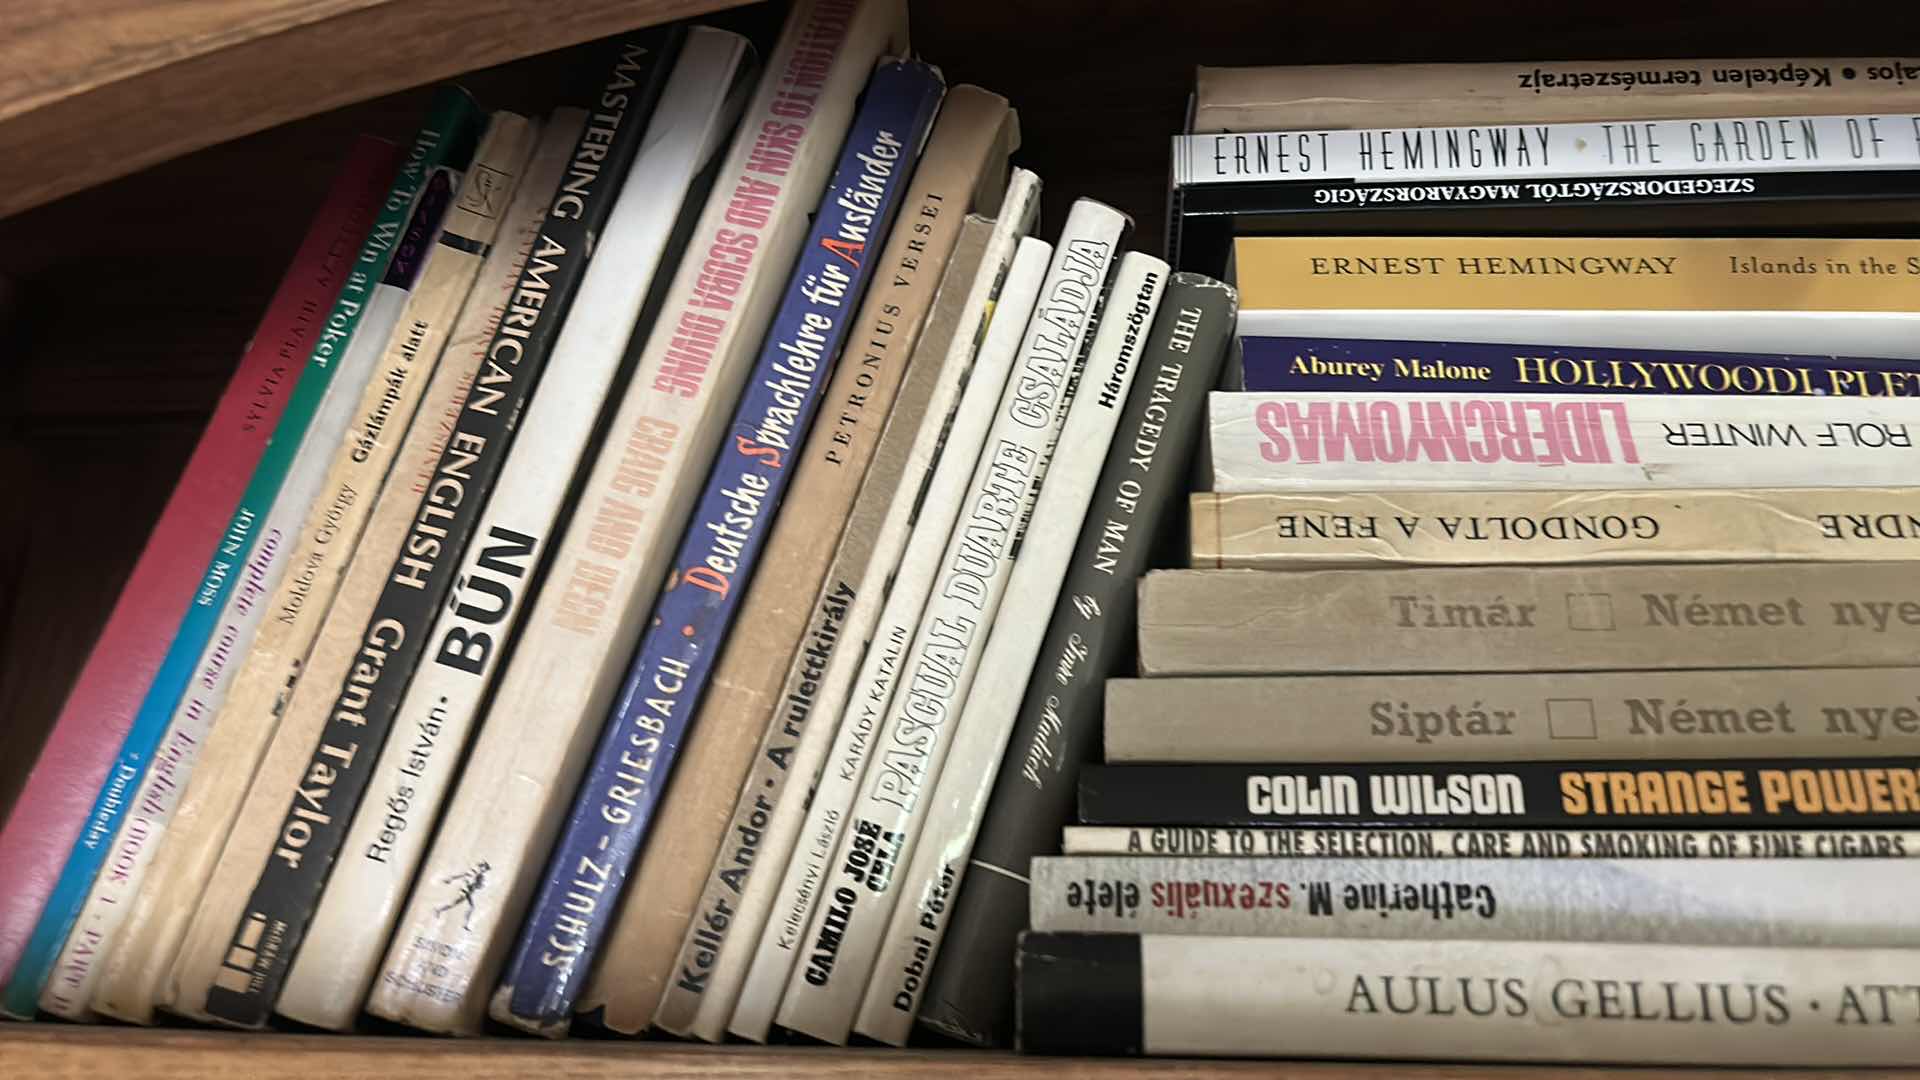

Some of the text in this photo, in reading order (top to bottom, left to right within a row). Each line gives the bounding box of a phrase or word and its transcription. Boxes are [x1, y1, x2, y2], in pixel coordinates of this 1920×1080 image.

[770, 89, 818, 119] TO
[1518, 69, 1701, 94] természetrajz
[1713, 66, 1832, 88] Képtelen
[403, 128, 442, 180] How
[551, 43, 650, 221] MASTERING
[745, 119, 806, 177] SKIN
[1214, 133, 1329, 176] ERNEST
[1359, 127, 1550, 172] HEMINGWAY
[1602, 123, 1663, 165] THE
[1689, 120, 1819, 162] GARDEN
[1845, 117, 1885, 159] OF
[724, 174, 782, 230] AND
[1313, 177, 1756, 206] SZEGEDORSZÁGTÓL MAGYARORSZÁGIG
[346, 271, 368, 294] at
[359, 221, 400, 264] Win
[687, 227, 760, 312] SCUBA
[1310, 257, 1445, 276] ERNEST
[1458, 256, 1678, 276] HEMINGWAY
[1728, 255, 1818, 275] Islands
[1825, 258, 1851, 275] in
[1859, 256, 1898, 275] the
[242, 367, 287, 432] SYLVIA
[280, 299, 319, 360] PLATH
[312, 299, 361, 369] Poker
[468, 234, 568, 417] AMERICAN
[652, 310, 727, 400] DIVING
[683, 128, 904, 601] Deutsche Sprachlehre für Ausländer
[824, 191, 945, 467] PETRONIUS VERSEI
[1096, 270, 1160, 410] Háromszögtan
[350, 366, 409, 464] Gázlámpák
[401, 319, 430, 363] alatt
[1288, 355, 1385, 382] Aburey
[1392, 357, 1492, 381] Malone
[1512, 355, 1813, 395] HOLLYWOODI
[609, 414, 681, 498] CRAIG
[1092, 306, 1204, 576] THE TRAGEDY OF MAN
[1254, 400, 1913, 467] ROLF WINTER LIDÉRCNYOMÁS
[393, 429, 488, 590] ENGLISH
[586, 496, 646, 561] AND
[871, 238, 1111, 814] PASCUAL DUARTE CSALÁDJA
[1275, 515, 1379, 539] FENE
[1394, 516, 1420, 539] A
[1437, 514, 1660, 540] GONDOLTA
[196, 507, 257, 607] JOHN MOSS
[236, 528, 283, 617] complete
[278, 480, 359, 625] Moldova György
[432, 524, 539, 677] BŰN
[1389, 594, 1537, 628] Timár
[1641, 593, 1807, 627] Német
[202, 623, 241, 691] course
[1021, 594, 1102, 790] by Imre Madách
[185, 698, 211, 721] in
[276, 617, 406, 870] Grant Taylor
[840, 625, 909, 781] KARÁDY KATALIN
[1369, 700, 1517, 744] Siptár
[1623, 699, 1796, 735] Német
[84, 760, 138, 851] Doubleday
[143, 730, 197, 816] English
[365, 707, 450, 864] Regős István
[542, 654, 692, 971] SCHULZ GRIESBACH
[676, 579, 858, 996] Kellér Andor A rulettkirály
[1247, 769, 1920, 816] COLIN WILSON STRANGE POWER
[777, 808, 841, 951] Kelecsényi László
[1127, 829, 1143, 852] A
[1150, 828, 1218, 852] GUIDE
[1227, 829, 1255, 853] TO
[1263, 830, 1305, 855] THE
[1450, 832, 1511, 857] CARE
[1523, 832, 1572, 857] AND
[1579, 832, 1699, 857] SMOKING
[1707, 832, 1739, 857] OF
[1749, 833, 1804, 857] FINE
[1814, 833, 1906, 857] CIGARS
[804, 817, 883, 987] CAMILO JOSÉ
[892, 863, 957, 1013] Dobai Péter
[1066, 879, 1497, 919] Catherine M. szexuális élete
[1344, 973, 1528, 1018] AULUS
[1551, 978, 1791, 1026] GELLIUS
